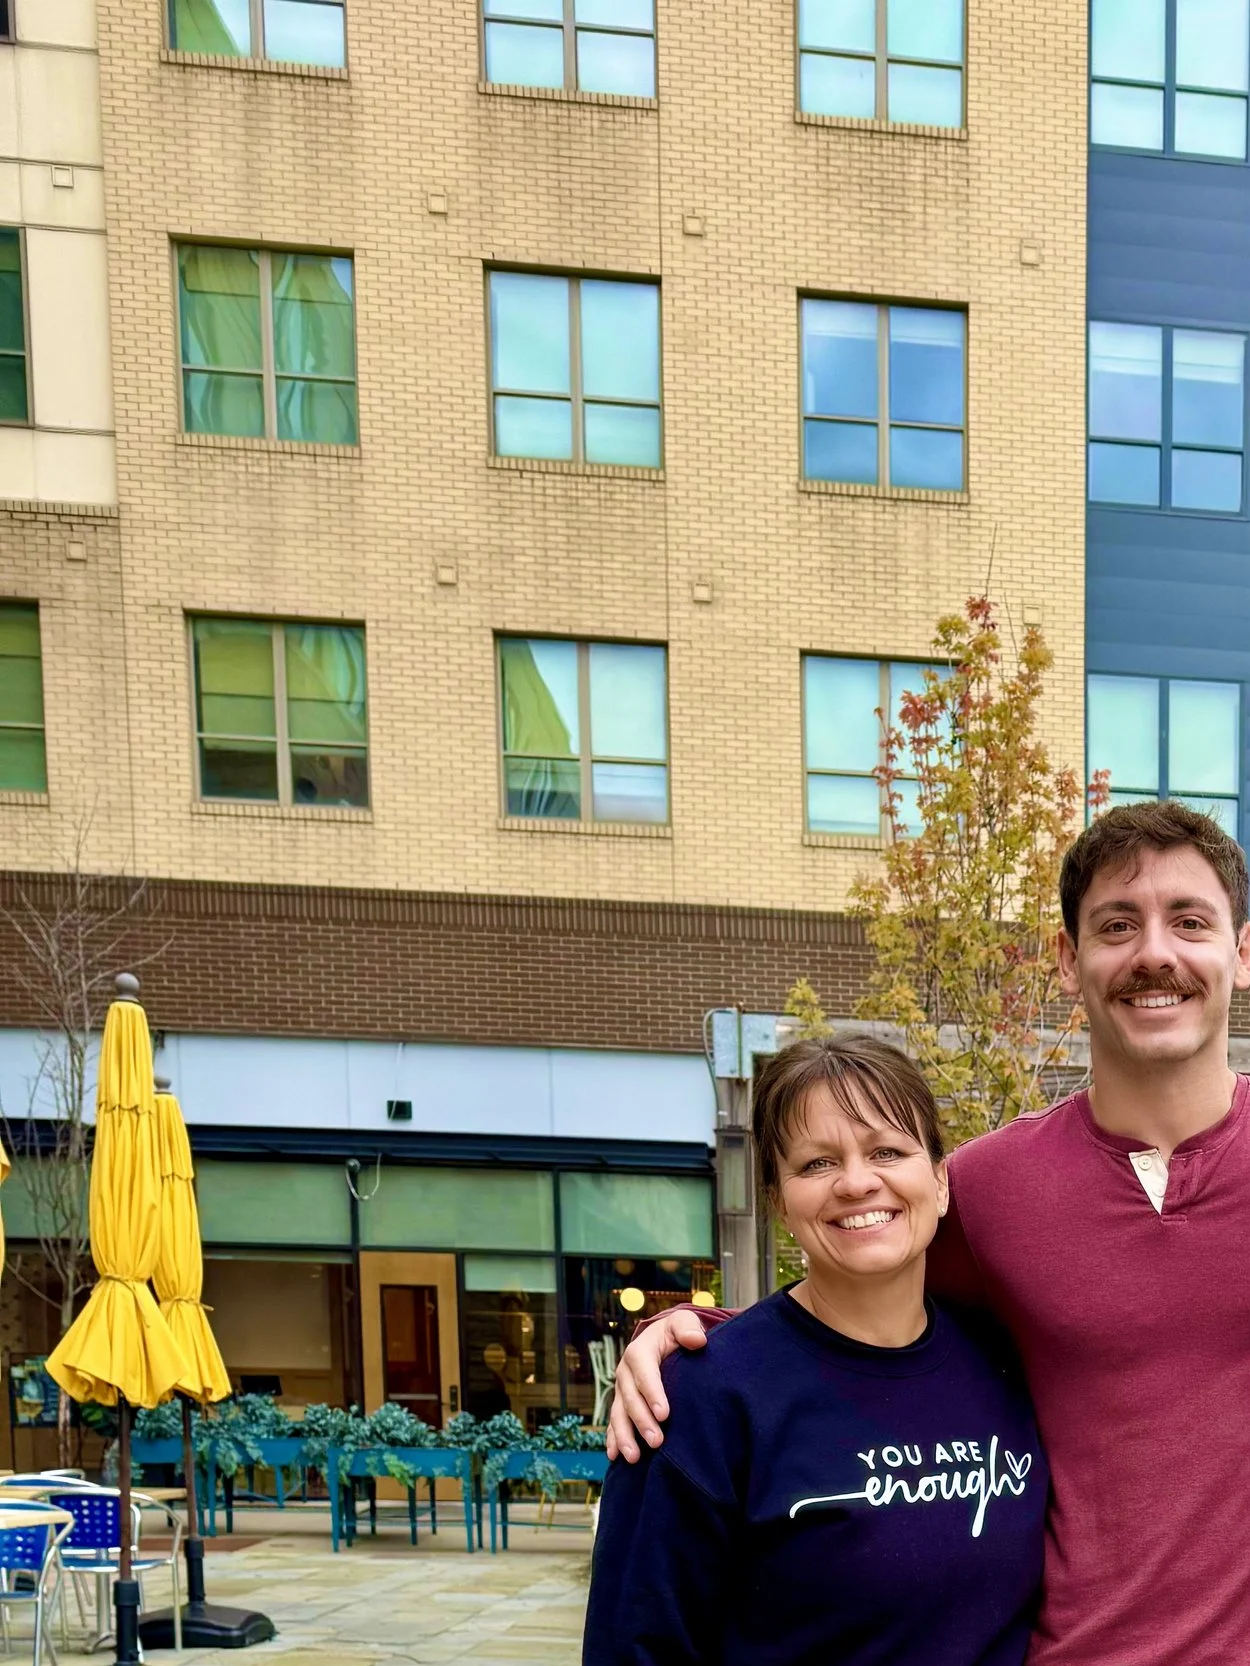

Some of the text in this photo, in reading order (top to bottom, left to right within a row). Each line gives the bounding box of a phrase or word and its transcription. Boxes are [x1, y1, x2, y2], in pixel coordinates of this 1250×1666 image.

[789, 1435, 1026, 1537] enough
[857, 1441, 984, 1470] YOU ARE
